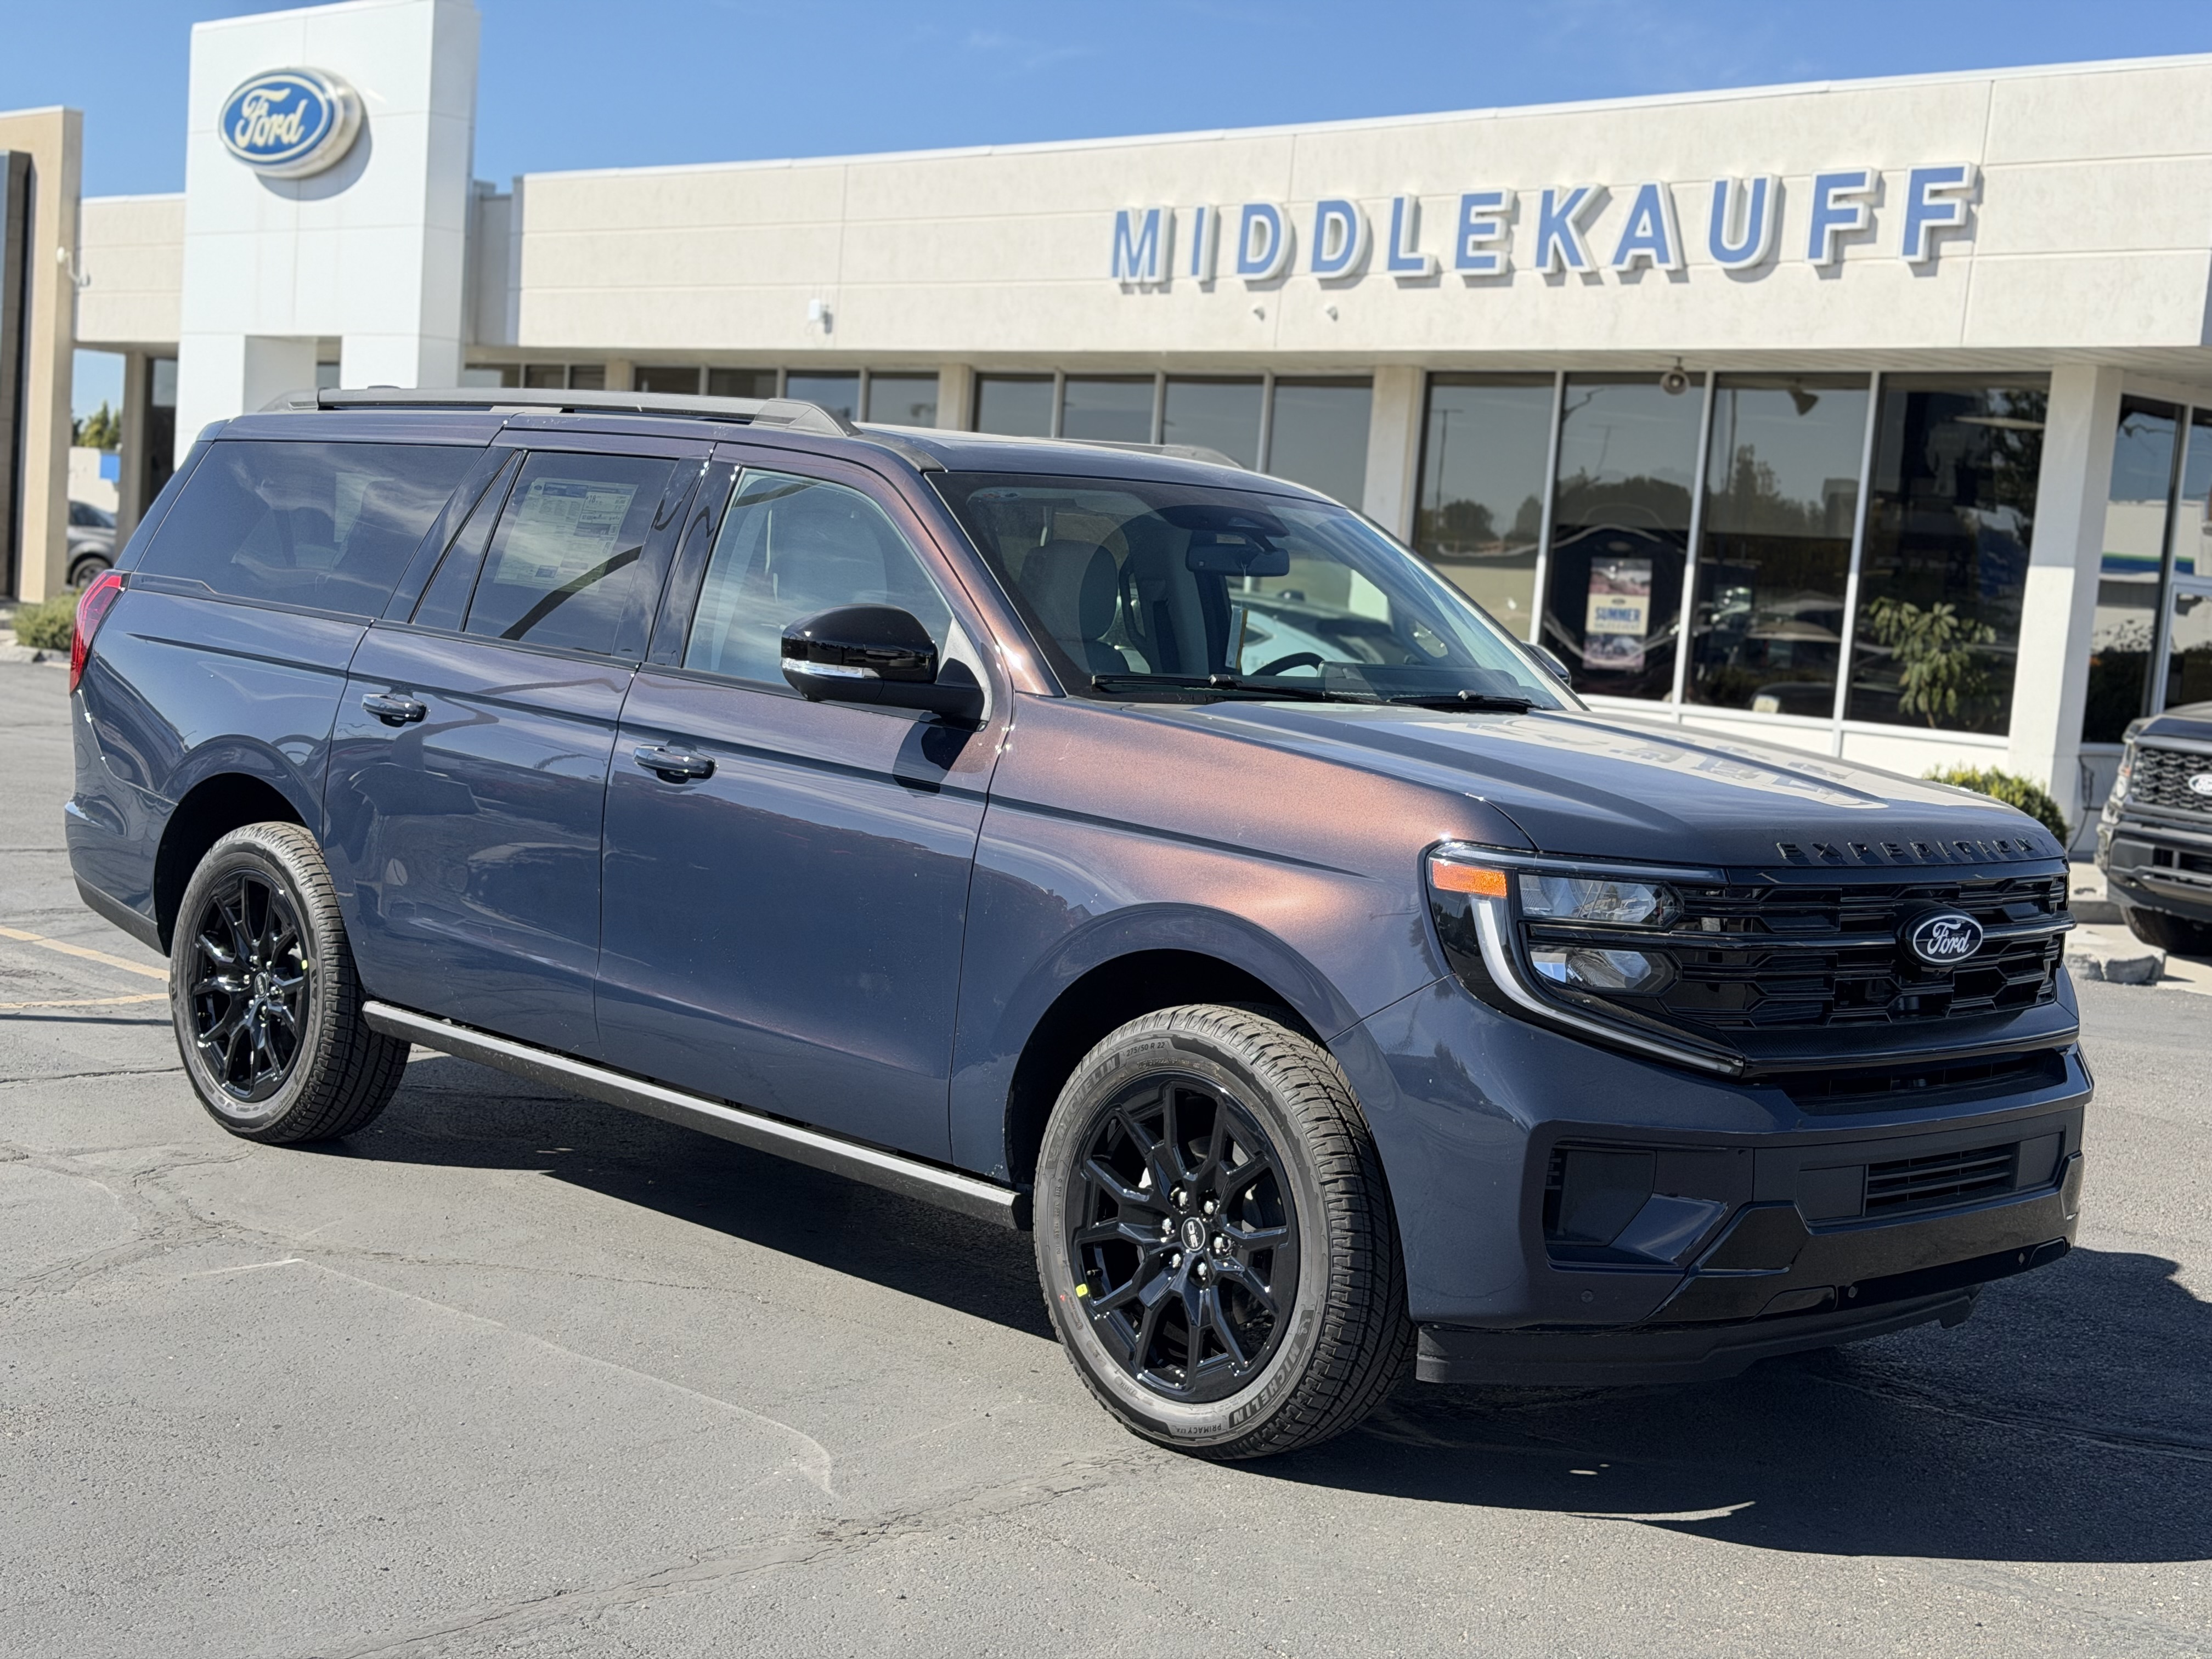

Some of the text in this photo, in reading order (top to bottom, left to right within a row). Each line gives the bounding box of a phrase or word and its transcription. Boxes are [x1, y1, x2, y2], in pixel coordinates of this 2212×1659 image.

[235, 88, 309, 149] Ford
[1110, 162, 1977, 284] MIDDLEKAUFF
[1776, 838, 2034, 859] EXPEDITION
[1927, 922, 1972, 955] Ford
[1126, 1042, 1149, 1057] 275/50
[1057, 1057, 1116, 1139] MICHELIN
[1233, 1344, 1301, 1425] MICHELIN
[1188, 1423, 1222, 1434] PRIMACY
